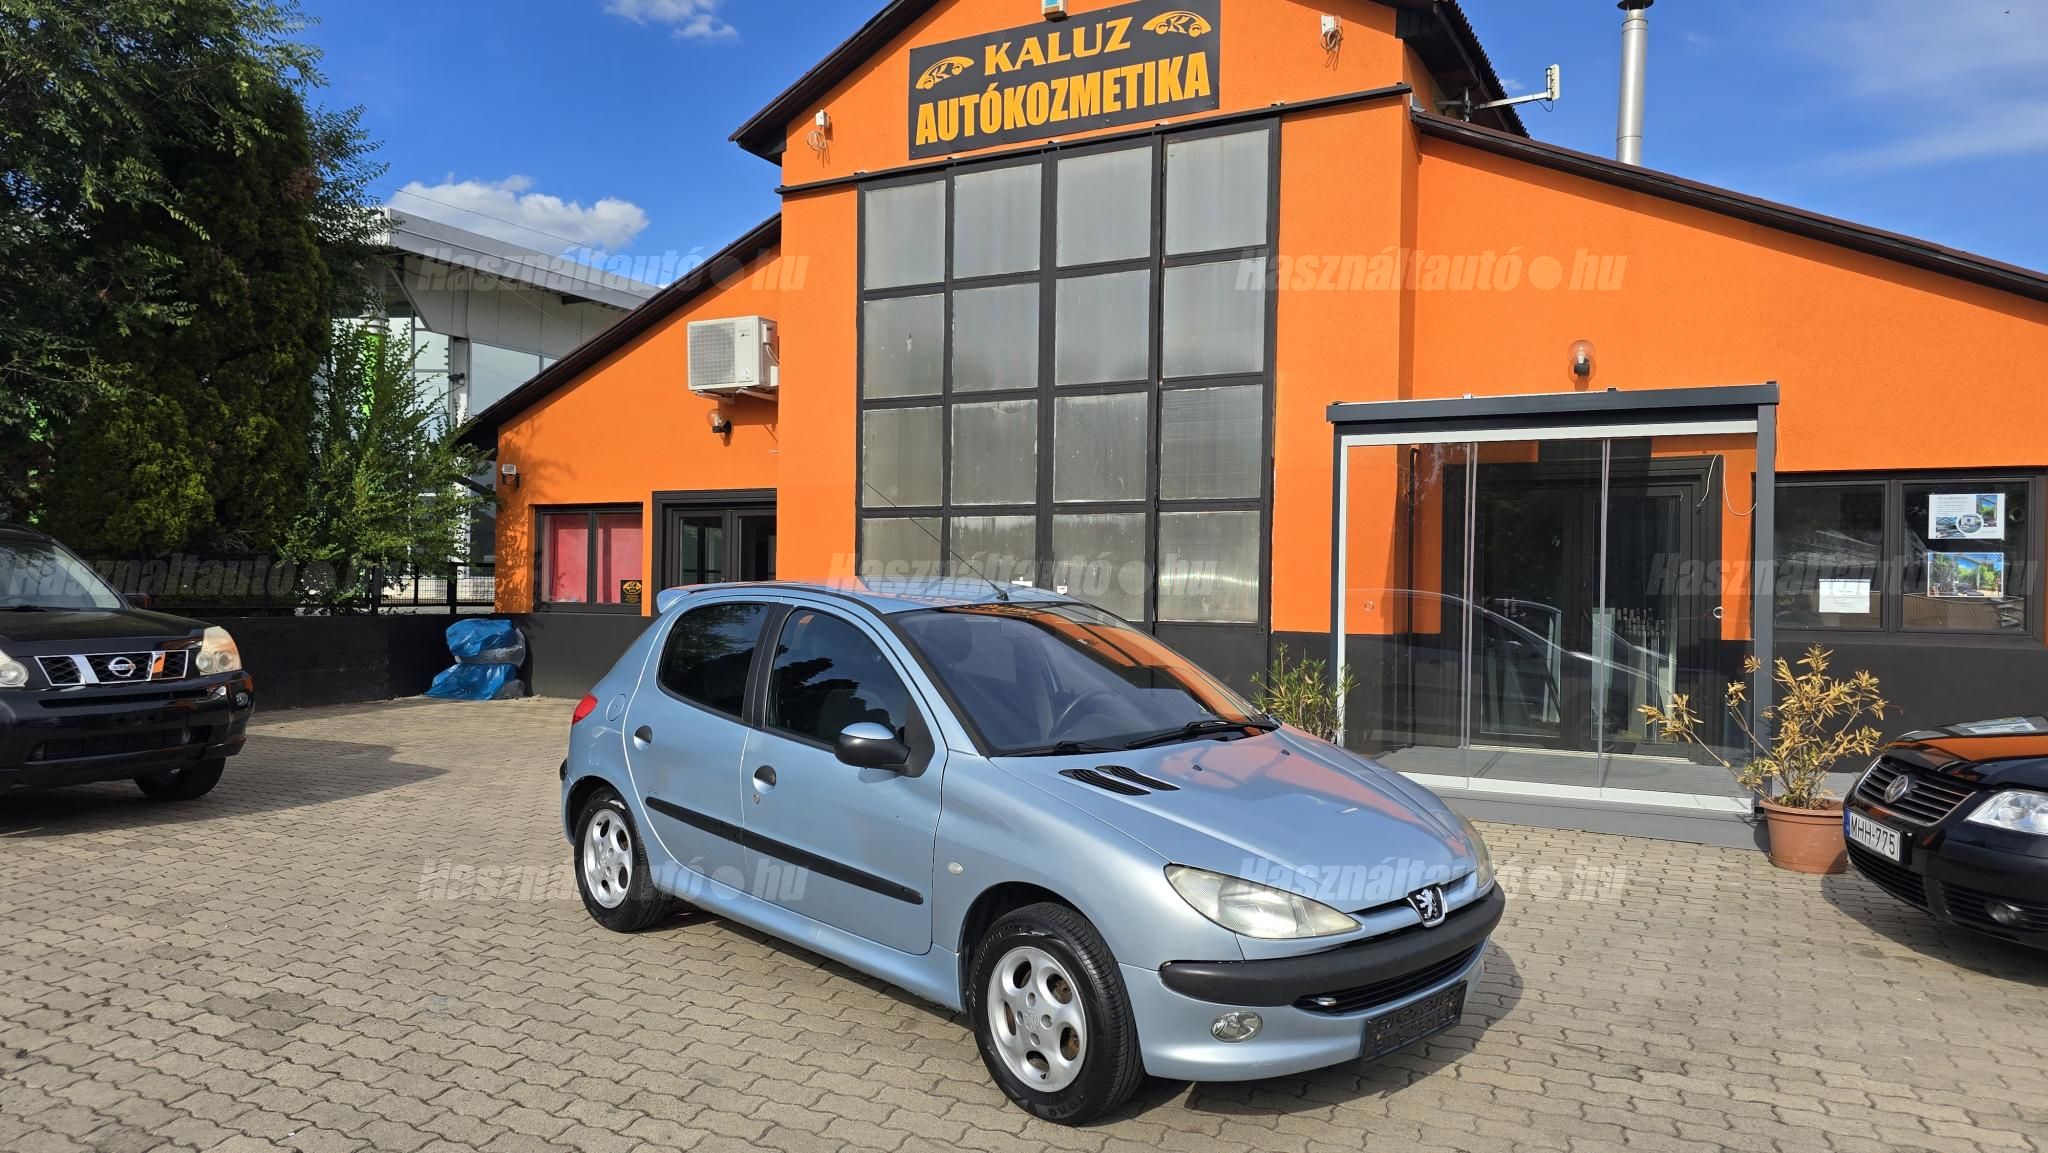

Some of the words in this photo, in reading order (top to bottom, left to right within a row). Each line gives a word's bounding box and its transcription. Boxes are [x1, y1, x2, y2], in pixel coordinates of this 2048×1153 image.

[984, 17, 1133, 76] KALUZ
[915, 51, 1212, 146] AUTÓKOZMETIKA
[1851, 815, 1895, 856] MHH-775
